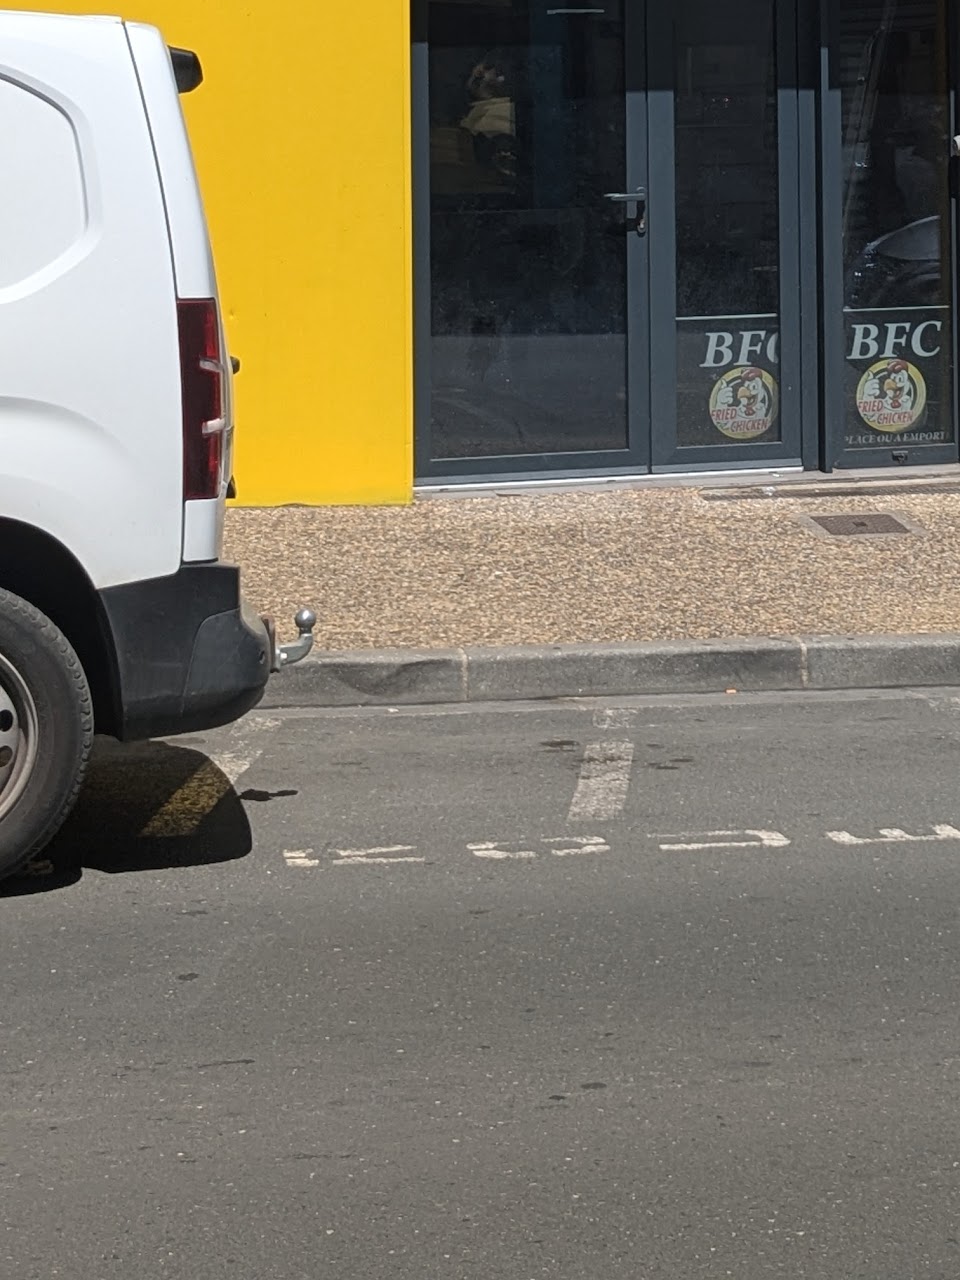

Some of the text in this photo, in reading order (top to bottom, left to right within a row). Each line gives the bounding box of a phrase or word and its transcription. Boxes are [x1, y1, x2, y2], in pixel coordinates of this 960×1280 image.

[846, 321, 942, 360] BFC
[858, 400, 883, 413] FRIED
[711, 408, 737, 421] FRIED
[877, 411, 913, 425] CHICKEN
[731, 419, 769, 433] CHICKEN
[903, 431, 945, 442] EMPORT
